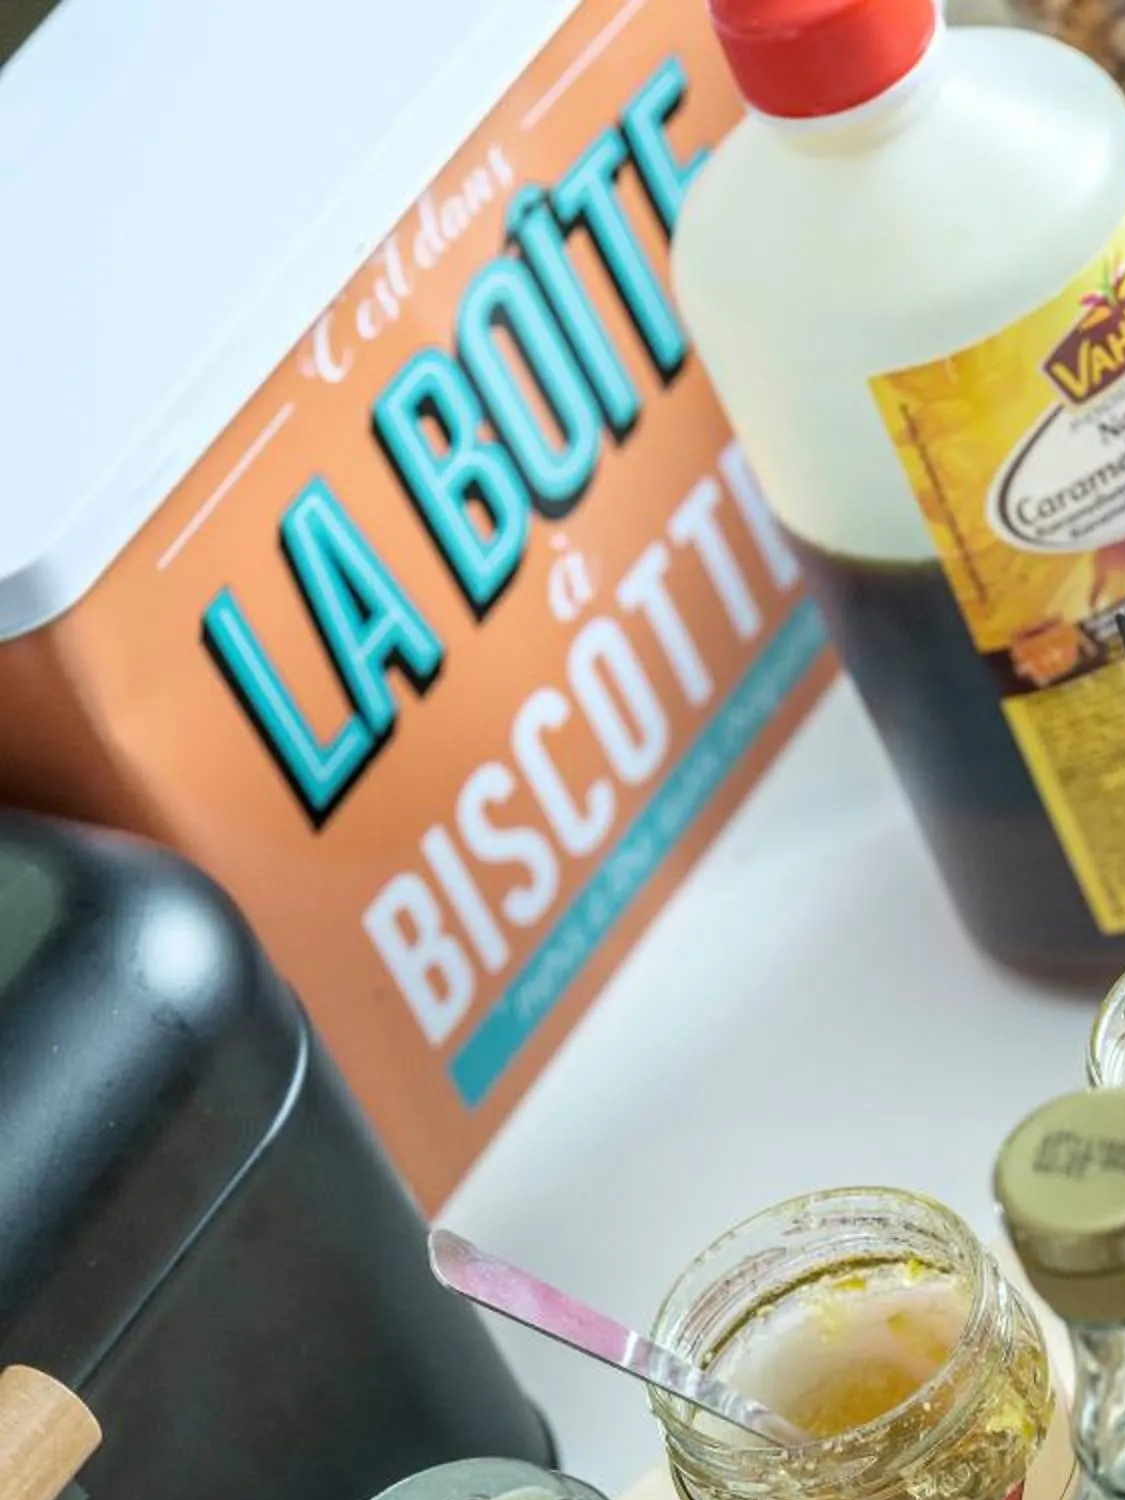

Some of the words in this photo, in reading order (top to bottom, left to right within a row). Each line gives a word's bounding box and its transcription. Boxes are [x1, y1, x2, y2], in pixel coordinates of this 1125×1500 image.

[412, 144, 514, 270] dans
[547, 532, 594, 622] à
[200, 473, 446, 833] LA
